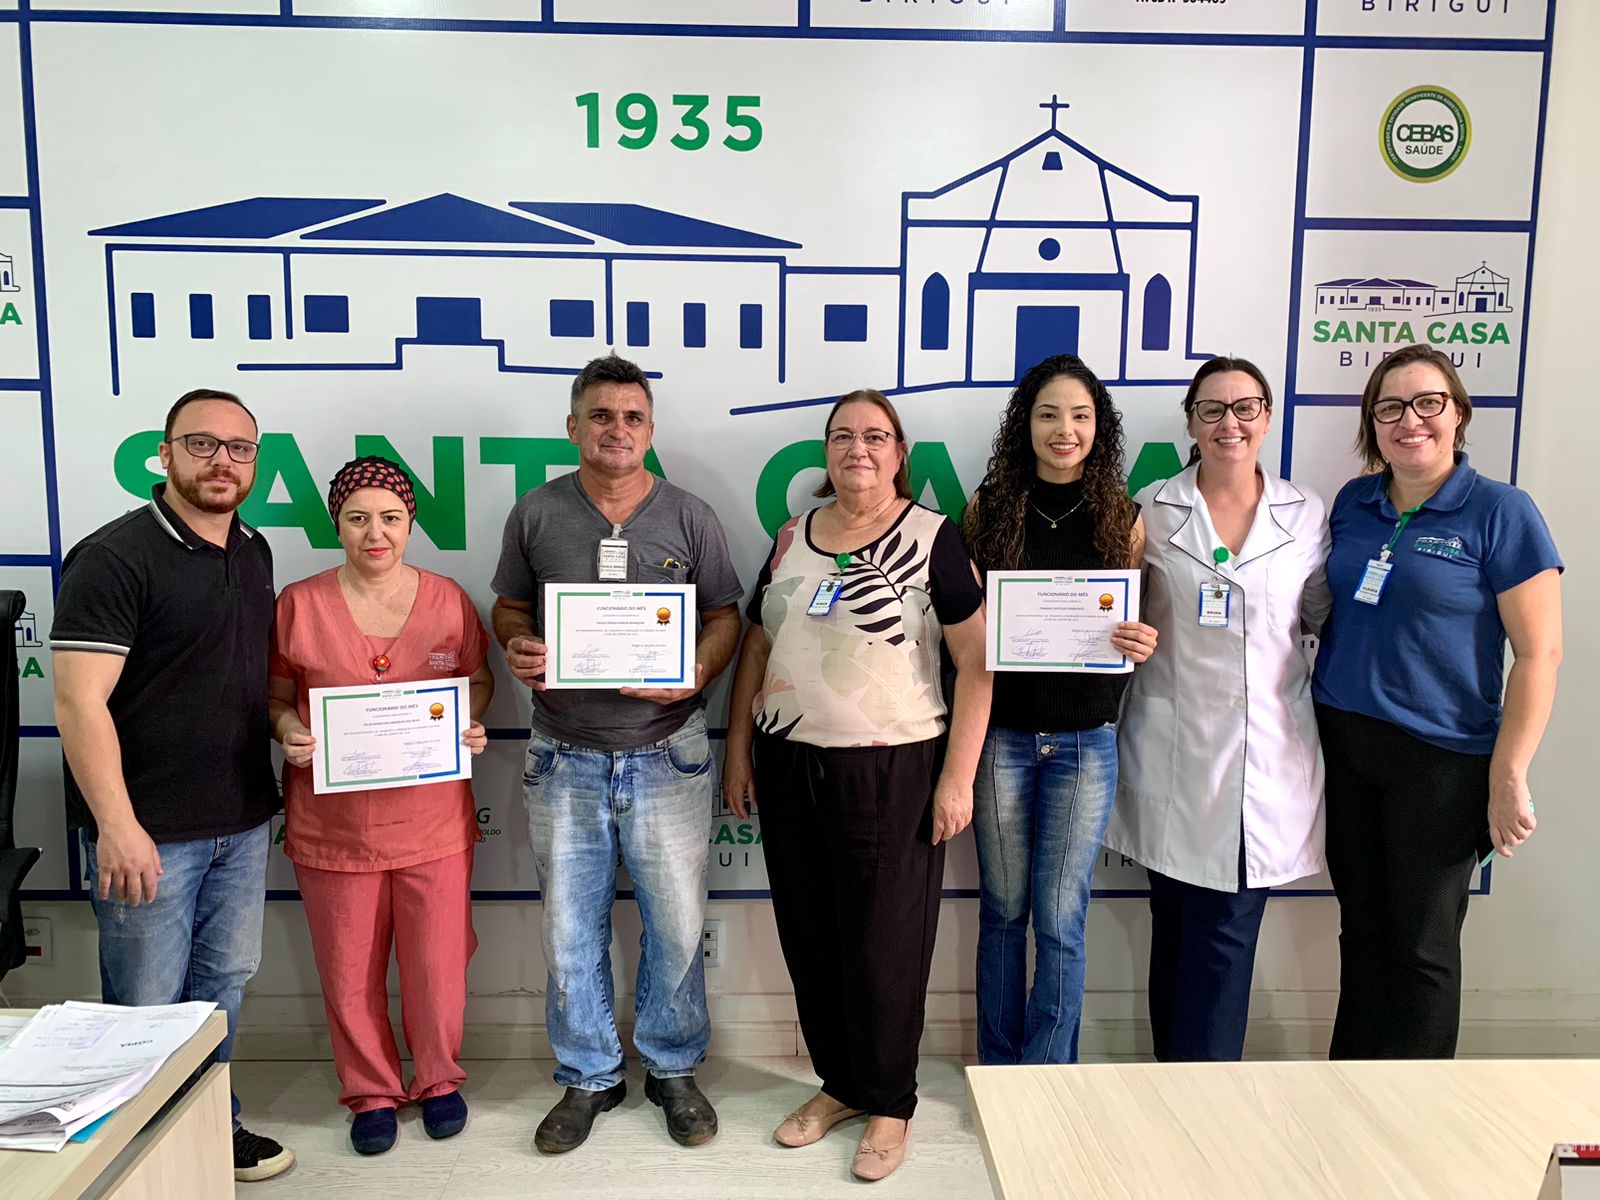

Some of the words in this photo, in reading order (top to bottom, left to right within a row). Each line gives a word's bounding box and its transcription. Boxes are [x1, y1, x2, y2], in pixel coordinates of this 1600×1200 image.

[576, 92, 763, 152] 1935
[1396, 124, 1454, 143] CEBAS
[1405, 143, 1444, 155] SAÚDE
[1312, 320, 1416, 344] SANTA
[1426, 322, 1511, 345] CASA
